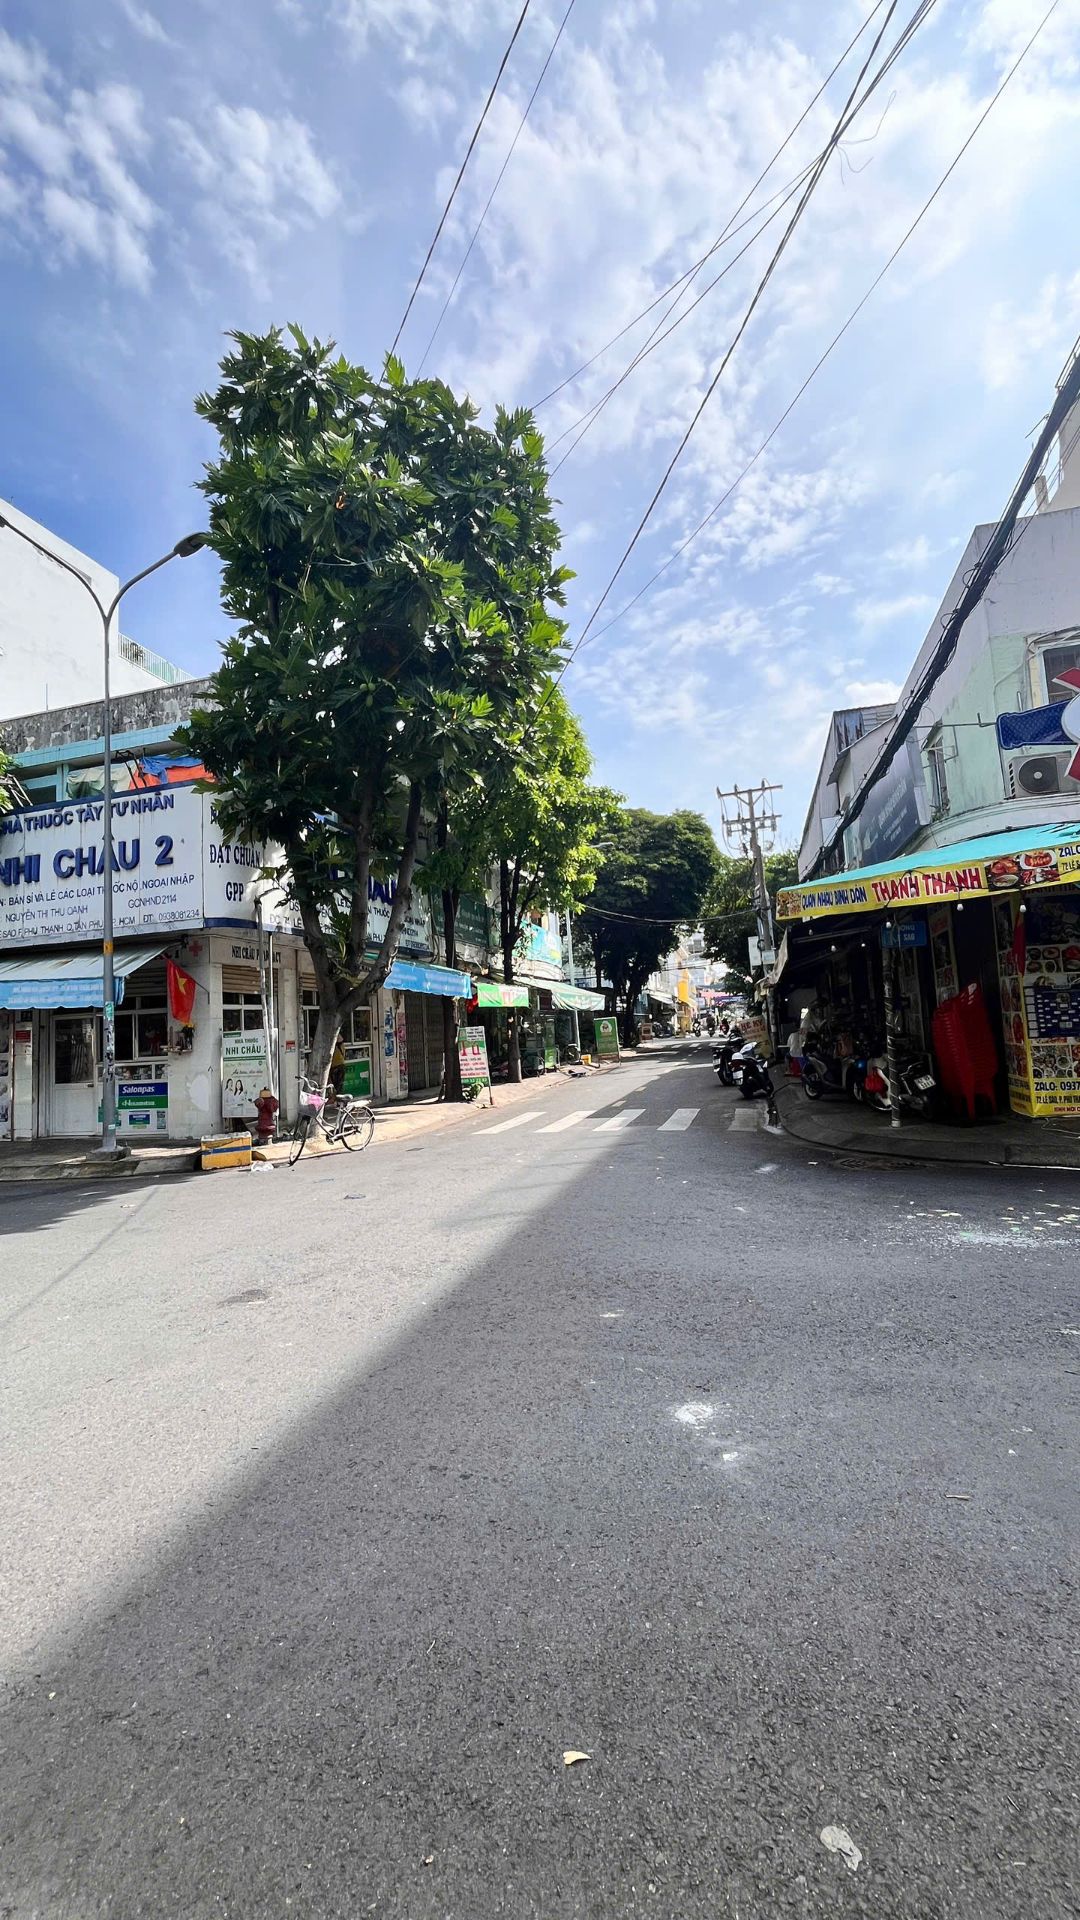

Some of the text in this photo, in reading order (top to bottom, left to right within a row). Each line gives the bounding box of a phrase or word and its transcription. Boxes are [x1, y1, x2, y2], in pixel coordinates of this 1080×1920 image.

[24, 807, 73, 831] THUỐC
[76, 804, 104, 823] TÂY
[131, 792, 174, 814] NHÂN
[155, 835, 174, 866] 2
[210, 844, 231, 868] ĐẠT
[58, 888, 74, 900] CÁC
[77, 887, 94, 898] LOẠI
[171, 873, 195, 886] NHẬP
[226, 881, 244, 902] GPP
[872, 875, 918, 902] THANH
[922, 867, 982, 895] THANH
[67, 905, 88, 916] OANH
[226, 1046, 239, 1055] NHI
[241, 1043, 261, 1055] CHÂU
[122, 1086, 155, 1095] Salonpas
